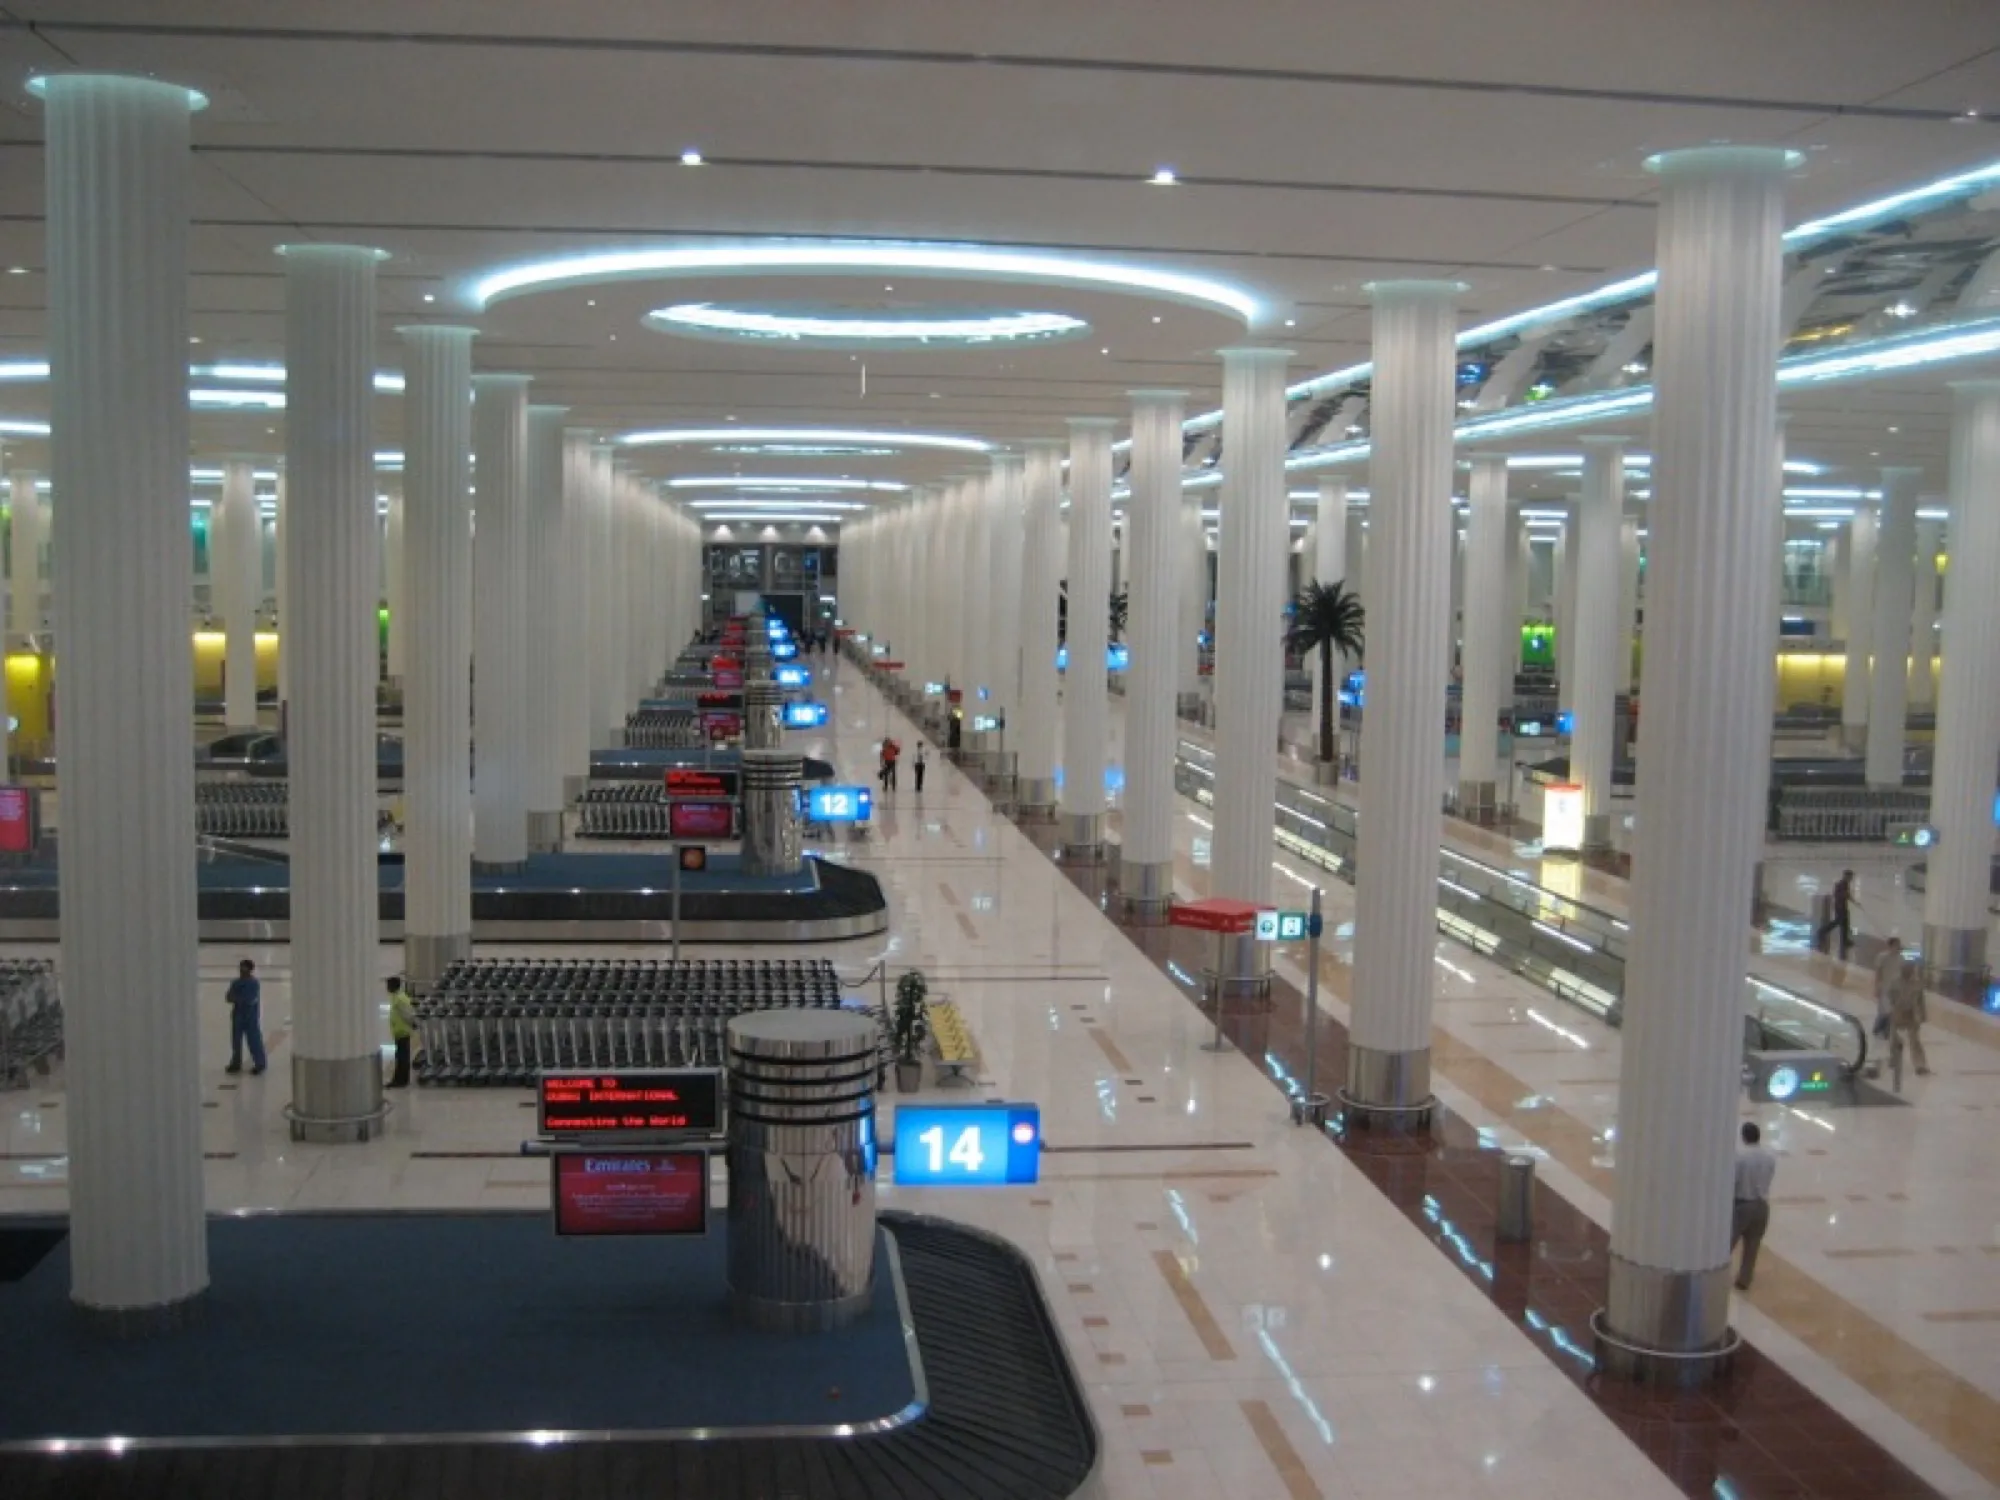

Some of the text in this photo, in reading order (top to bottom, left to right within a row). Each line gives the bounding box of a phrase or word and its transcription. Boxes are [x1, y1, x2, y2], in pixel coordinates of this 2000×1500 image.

[820, 792, 848, 816] 12
[545, 1079, 618, 1089] WELCOME TO
[622, 1115, 645, 1127] the
[650, 1114, 687, 1127] World
[919, 1124, 985, 1173] 14
[584, 1158, 652, 1174] Emirates
